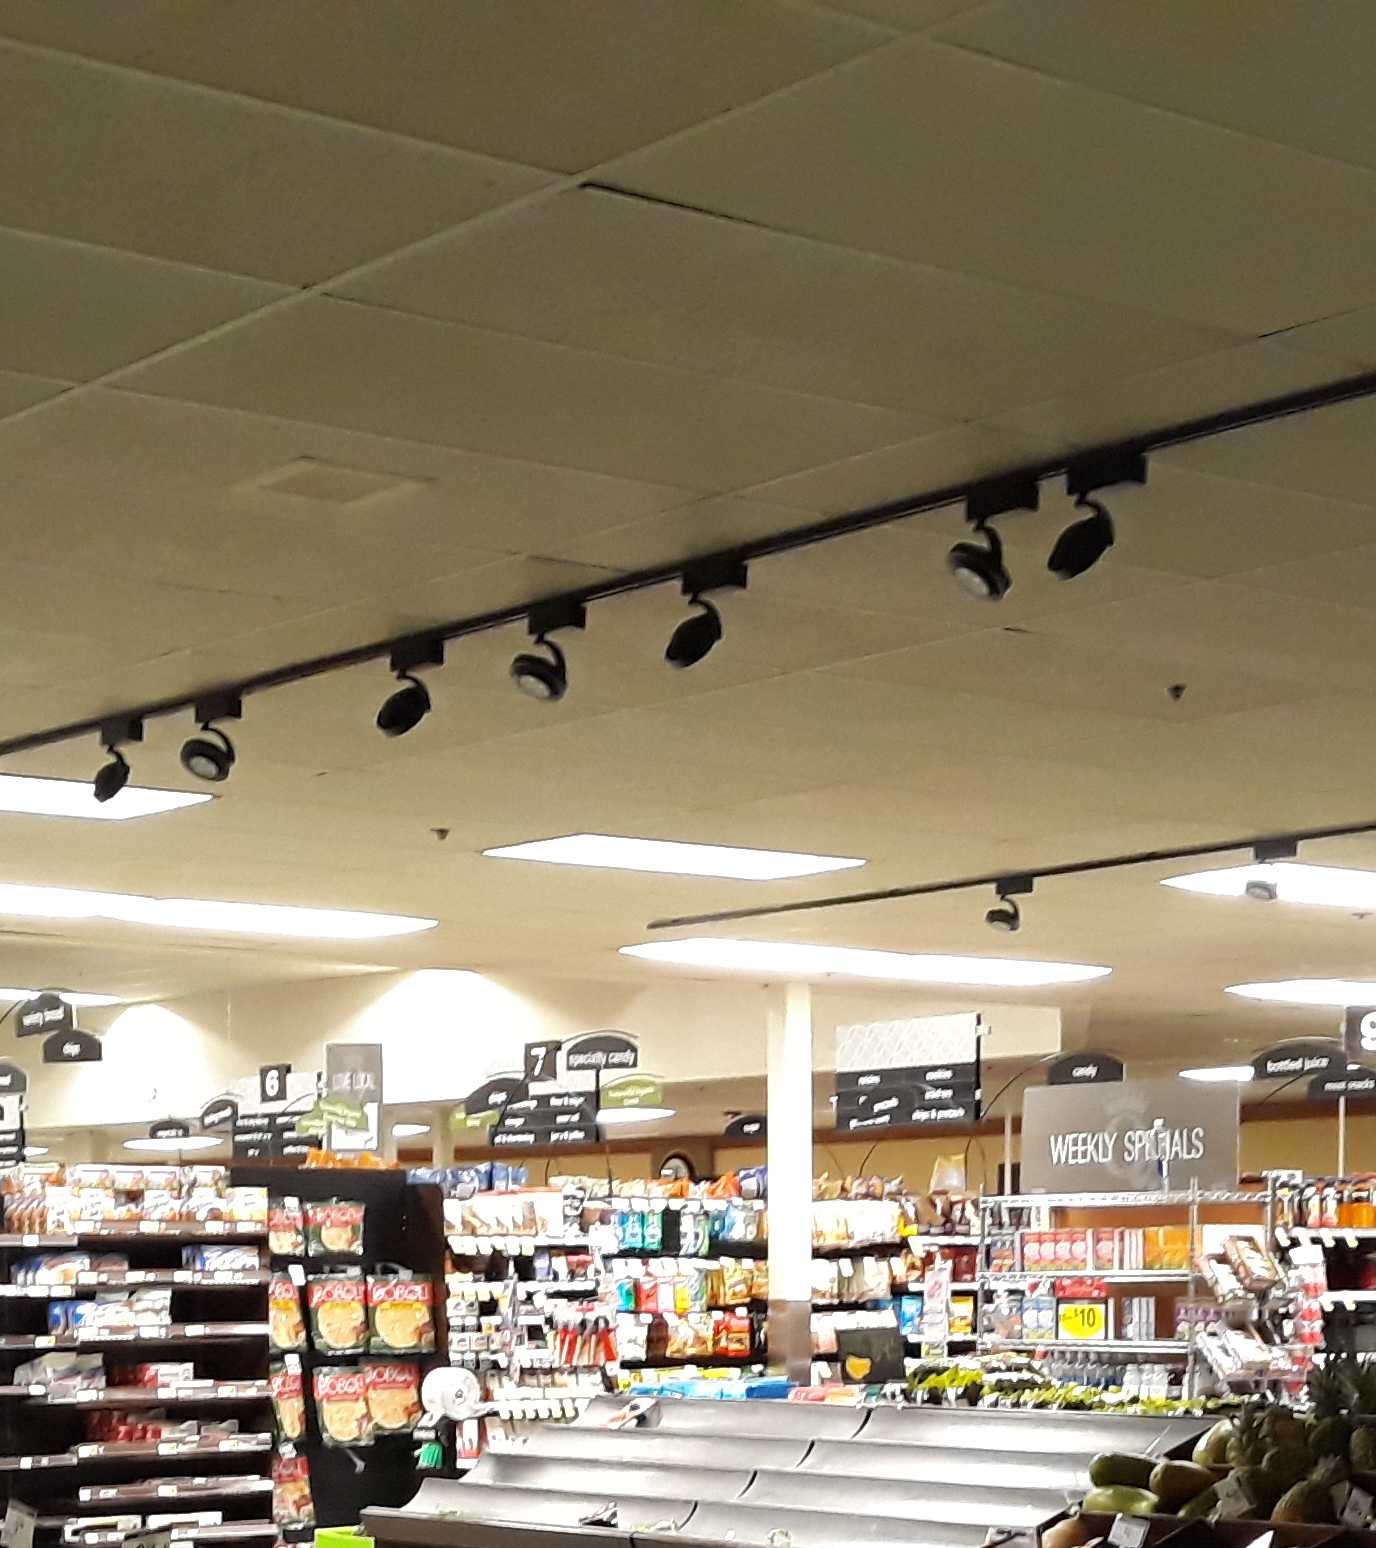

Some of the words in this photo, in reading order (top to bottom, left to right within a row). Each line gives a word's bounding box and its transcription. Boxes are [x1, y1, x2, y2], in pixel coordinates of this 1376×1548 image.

[530, 1046, 547, 1077] 7
[265, 1069, 280, 1097] 6
[1050, 1132, 1117, 1165] WEEKLY
[1074, 1307, 1096, 1328] $10
